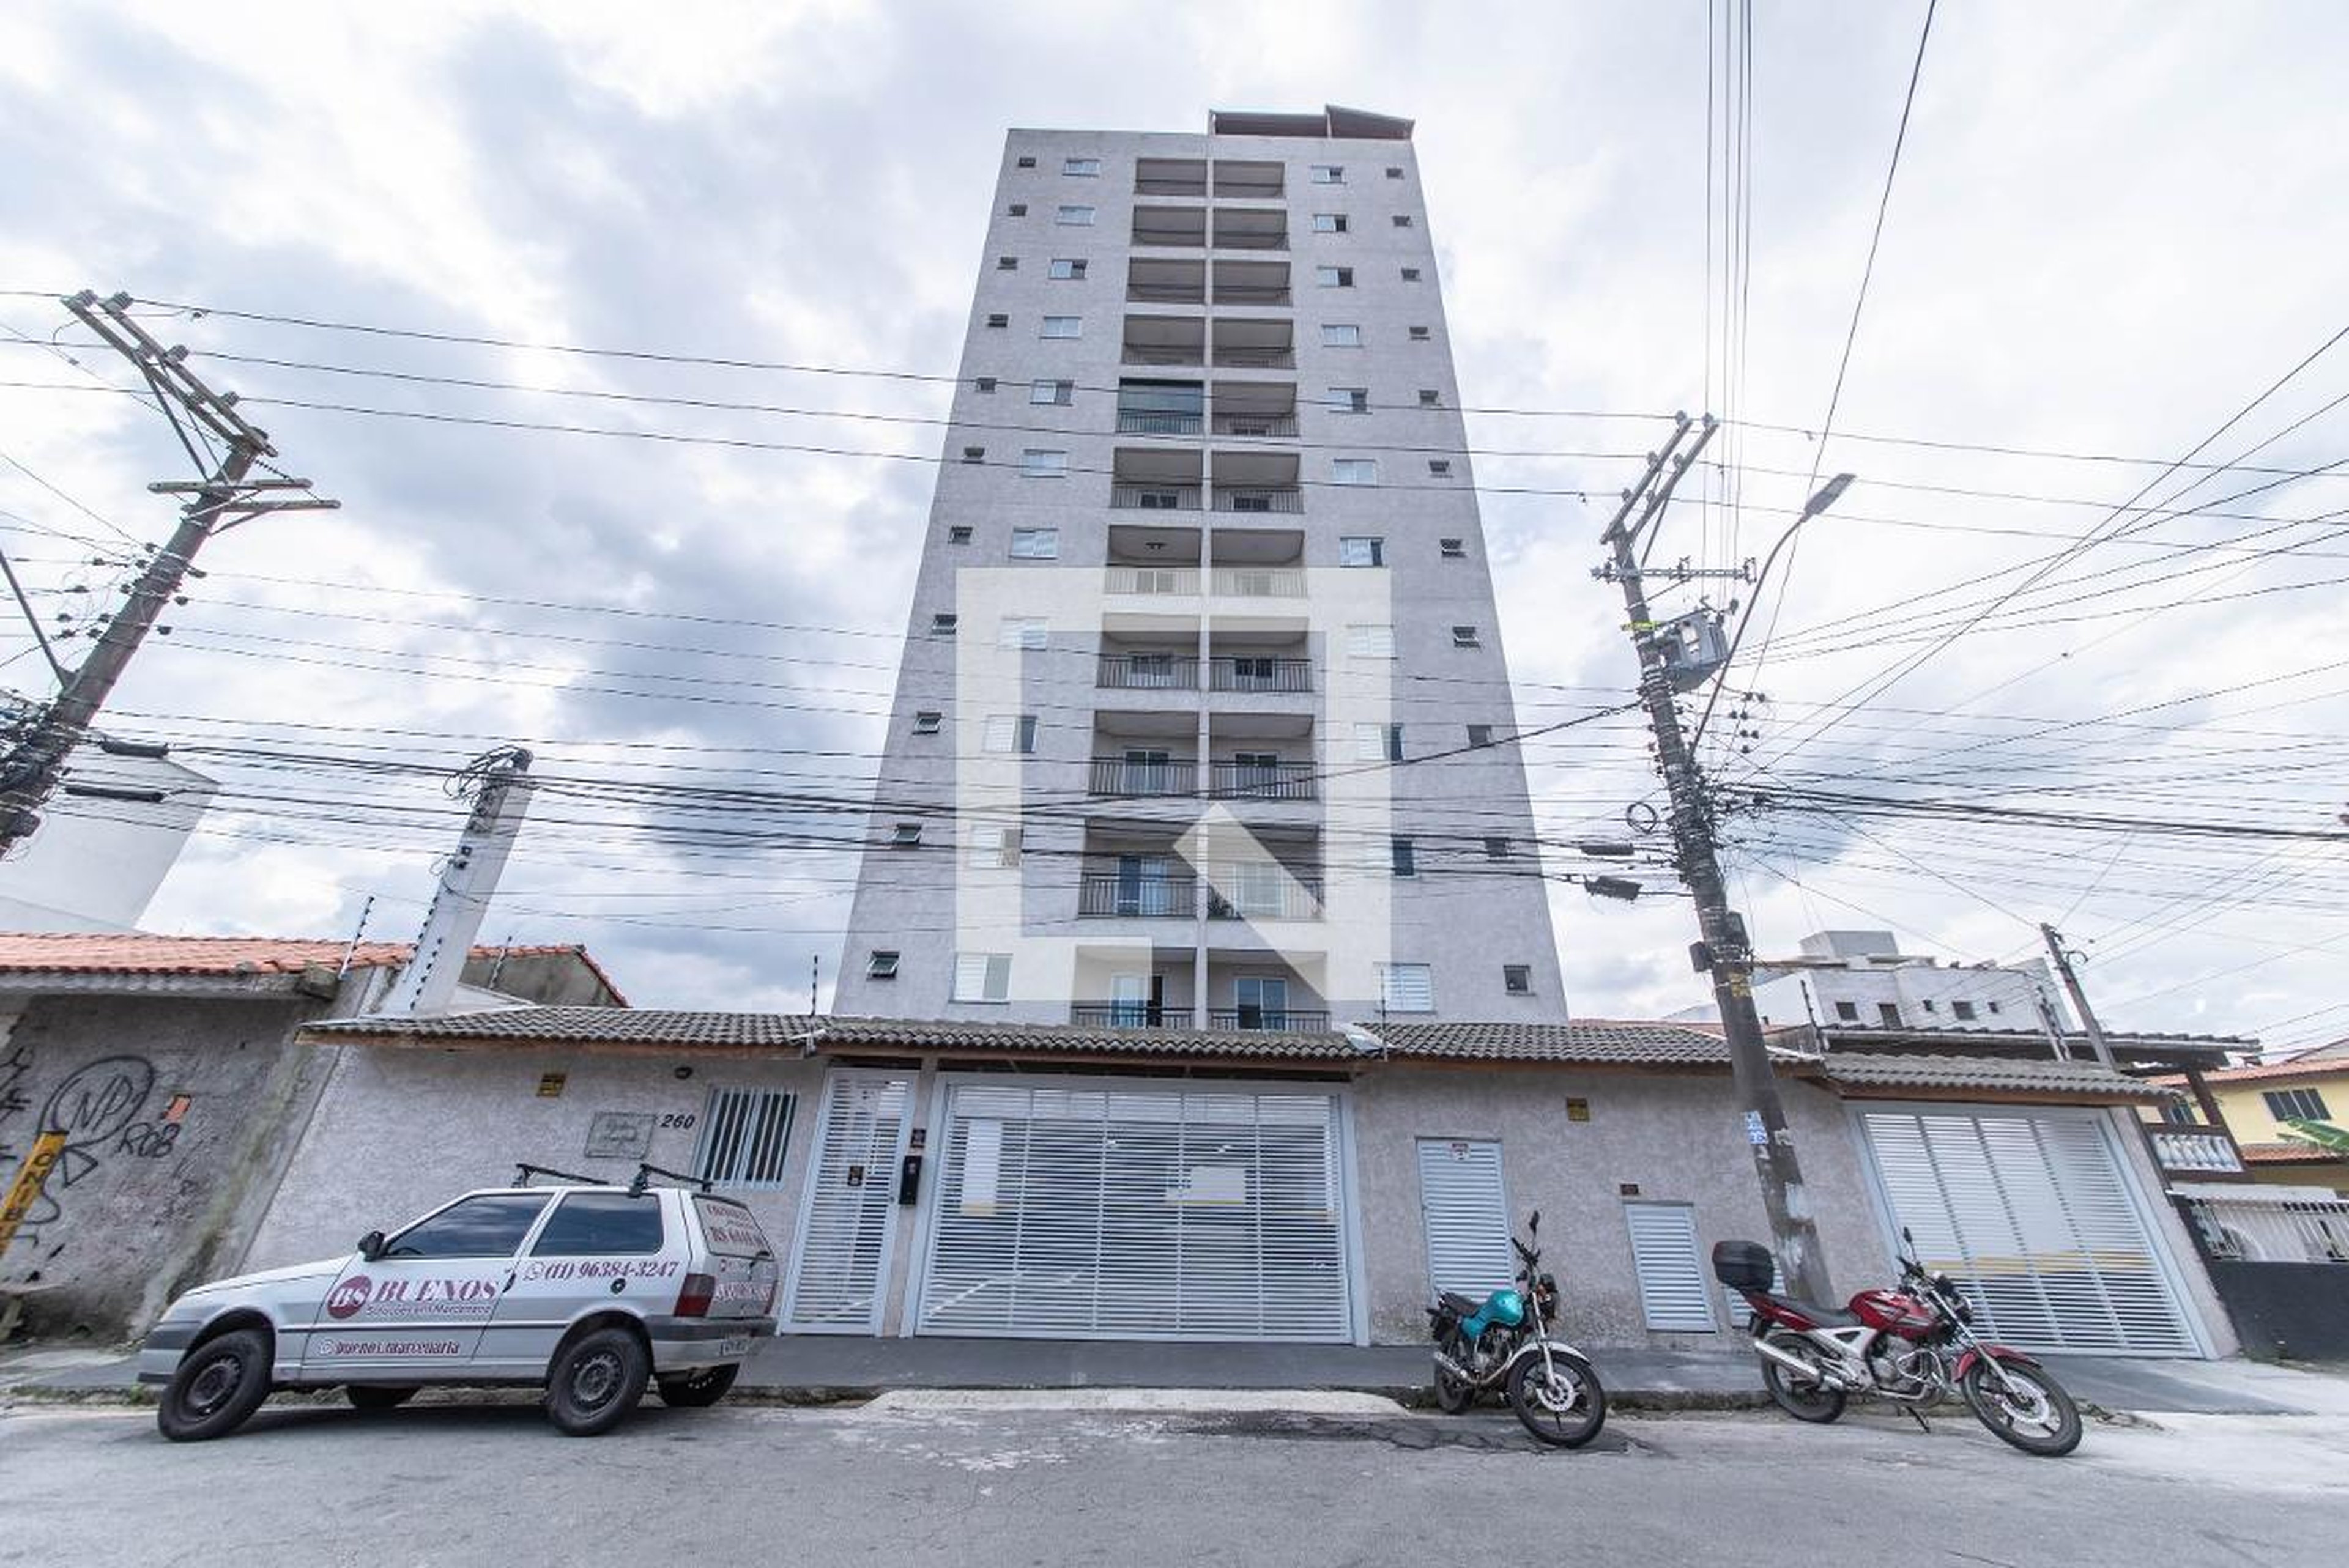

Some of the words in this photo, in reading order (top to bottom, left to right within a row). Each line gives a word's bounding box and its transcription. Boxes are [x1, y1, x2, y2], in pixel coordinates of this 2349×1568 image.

[660, 1114, 696, 1129] 260
[545, 1262, 575, 1280] (11)
[580, 1261, 679, 1278] 96384-3247
[331, 1287, 368, 1307] BS
[373, 1279, 498, 1302] BUENOS
